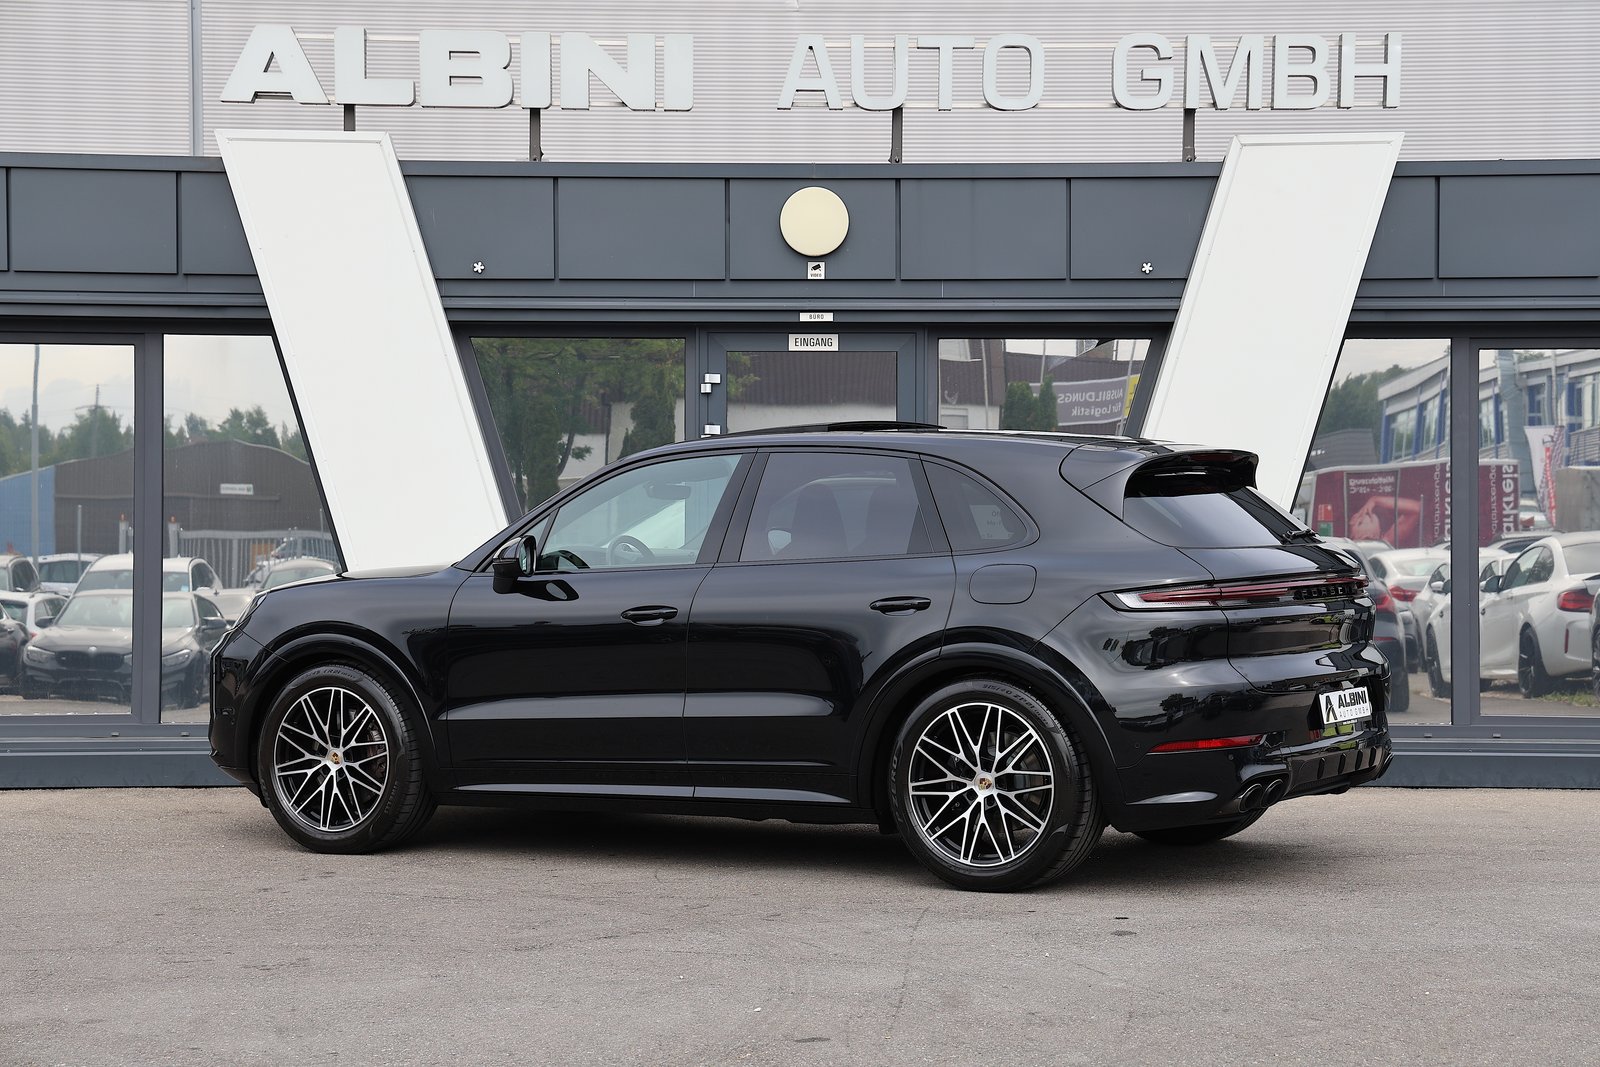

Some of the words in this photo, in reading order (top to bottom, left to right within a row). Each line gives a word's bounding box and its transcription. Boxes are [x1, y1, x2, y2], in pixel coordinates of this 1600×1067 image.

[220, 24, 694, 111] ALBINI
[777, 34, 1046, 111] AUTO
[1111, 32, 1403, 110] GMBH
[794, 337, 833, 347] EINGANG
[1338, 690, 1367, 709] ALBINI
[1339, 708, 1353, 718] AUTO
[888, 754, 899, 808] ZERO
